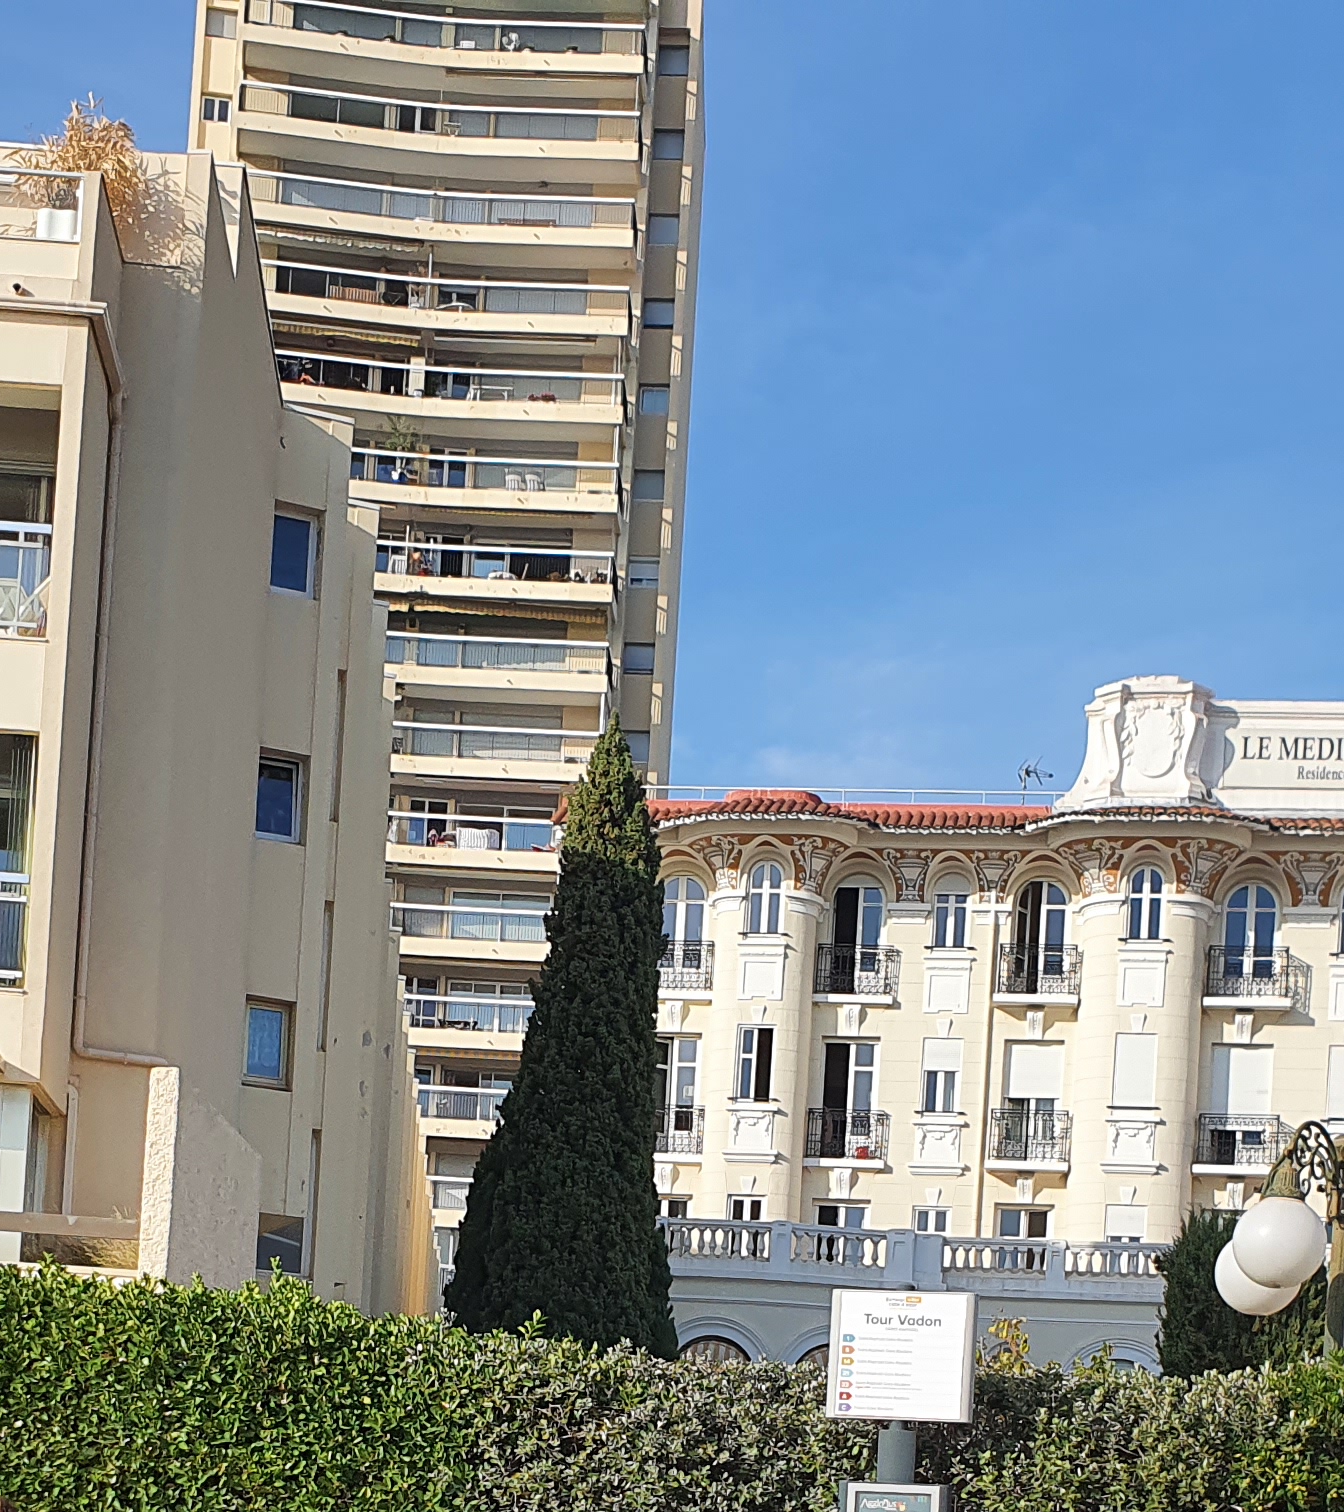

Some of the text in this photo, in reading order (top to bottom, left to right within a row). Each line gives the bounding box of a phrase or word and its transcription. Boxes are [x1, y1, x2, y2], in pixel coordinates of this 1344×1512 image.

[1240, 735, 1272, 760] LE
[864, 1313, 942, 1327] Tour Vadon
